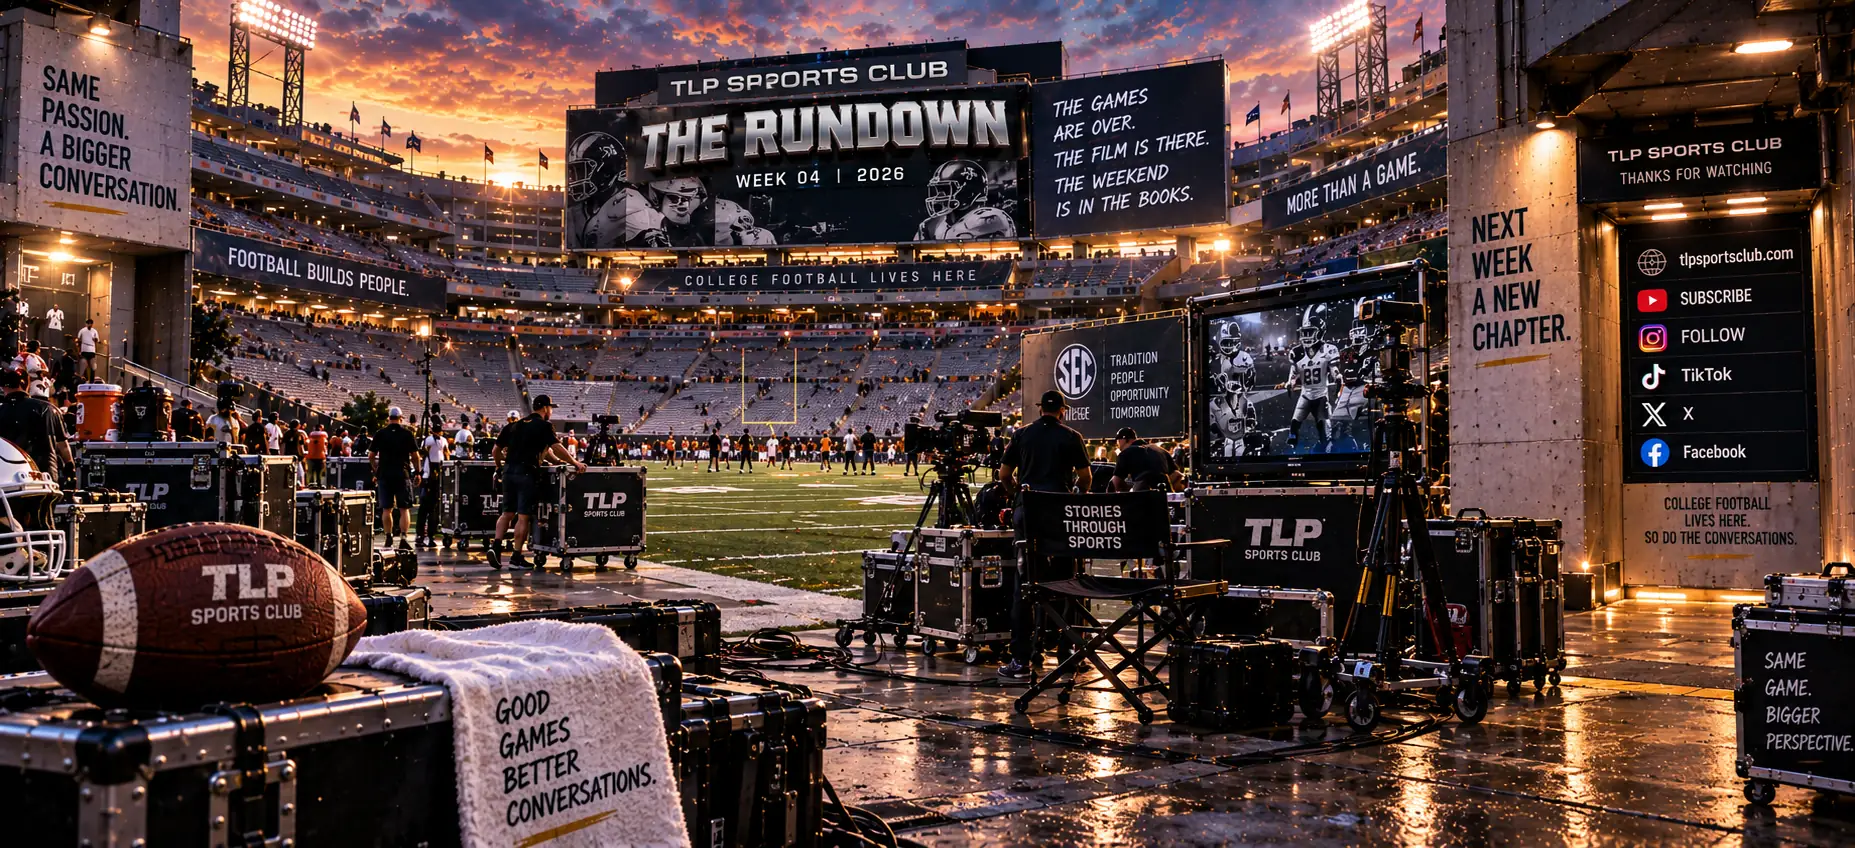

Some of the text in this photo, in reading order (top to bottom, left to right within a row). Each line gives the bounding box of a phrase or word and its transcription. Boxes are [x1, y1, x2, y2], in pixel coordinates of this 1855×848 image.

[43, 65, 100, 102] SAME
[671, 78, 719, 96] TLP
[869, 61, 948, 81] CLUB
[1053, 88, 1148, 117] THE GAMES
[42, 98, 128, 140] PASSION.
[1054, 115, 1135, 142] ARE OVER.
[642, 100, 1010, 168] THE RUNDOWN
[40, 130, 130, 172] A BIGGER
[1054, 130, 1208, 168] THE FILM IS THERE.
[1608, 138, 1781, 162] TLP SPORTS CLUB
[736, 167, 903, 188] WEEK 04 2026
[1055, 164, 1168, 194] THE WEEKEND
[1287, 152, 1421, 215] MORE THAN A GAME.
[1620, 162, 1772, 184] THANKS FOR WATCHING
[40, 163, 181, 212] CONVERSATION.
[1056, 186, 1193, 217] IS IN THE BOOKS.
[1472, 207, 1527, 244] NEXT
[1472, 244, 1533, 280] WEEK
[1680, 248, 1793, 268] tlpsportsclub.com
[229, 246, 409, 296] FOOTBALL BUILDS PEOPLE.
[685, 270, 975, 286] COLLEGE FOOTBALL LIVES HERE
[1472, 279, 1540, 316] A NEW
[1681, 288, 1752, 305] SUBSCRIBE
[1473, 314, 1571, 351] CHAPTER.
[1682, 328, 1745, 343] FOLLOW
[1110, 352, 1157, 366] TRADITION
[1058, 348, 1093, 395] SEC
[1111, 370, 1144, 384] PEOPLE
[1682, 367, 1732, 382] TikTok
[1111, 387, 1169, 402] OPPORTUNITY
[1110, 406, 1160, 419] TOMORROW
[1684, 407, 1693, 420] X
[1684, 444, 1746, 458] Facebook
[584, 493, 626, 509] TLP
[1065, 505, 1121, 517] STORIES
[1664, 497, 1771, 510] COLLEGE FOOTBALL
[1063, 520, 1126, 533] THROUGH
[1685, 514, 1750, 527] LIVES HERE.
[1069, 536, 1121, 548] SPORTS
[1245, 518, 1322, 546] TLP
[1645, 531, 1797, 545] SO DO THE CONVERSATIONS.
[1245, 550, 1320, 561] SPORTS CLUB
[202, 564, 294, 600] TLP
[192, 604, 302, 624] SPORTS CLUB
[1765, 652, 1806, 669] SAME
[1766, 679, 1811, 696] GAME.
[496, 690, 550, 726] GOOD
[1766, 706, 1820, 724] BIGGER
[499, 717, 571, 760] GAMES
[1767, 733, 1853, 751] PERSPECTIVE.
[502, 749, 580, 795] BETTER
[506, 762, 656, 827] CONVERSATIONS.
